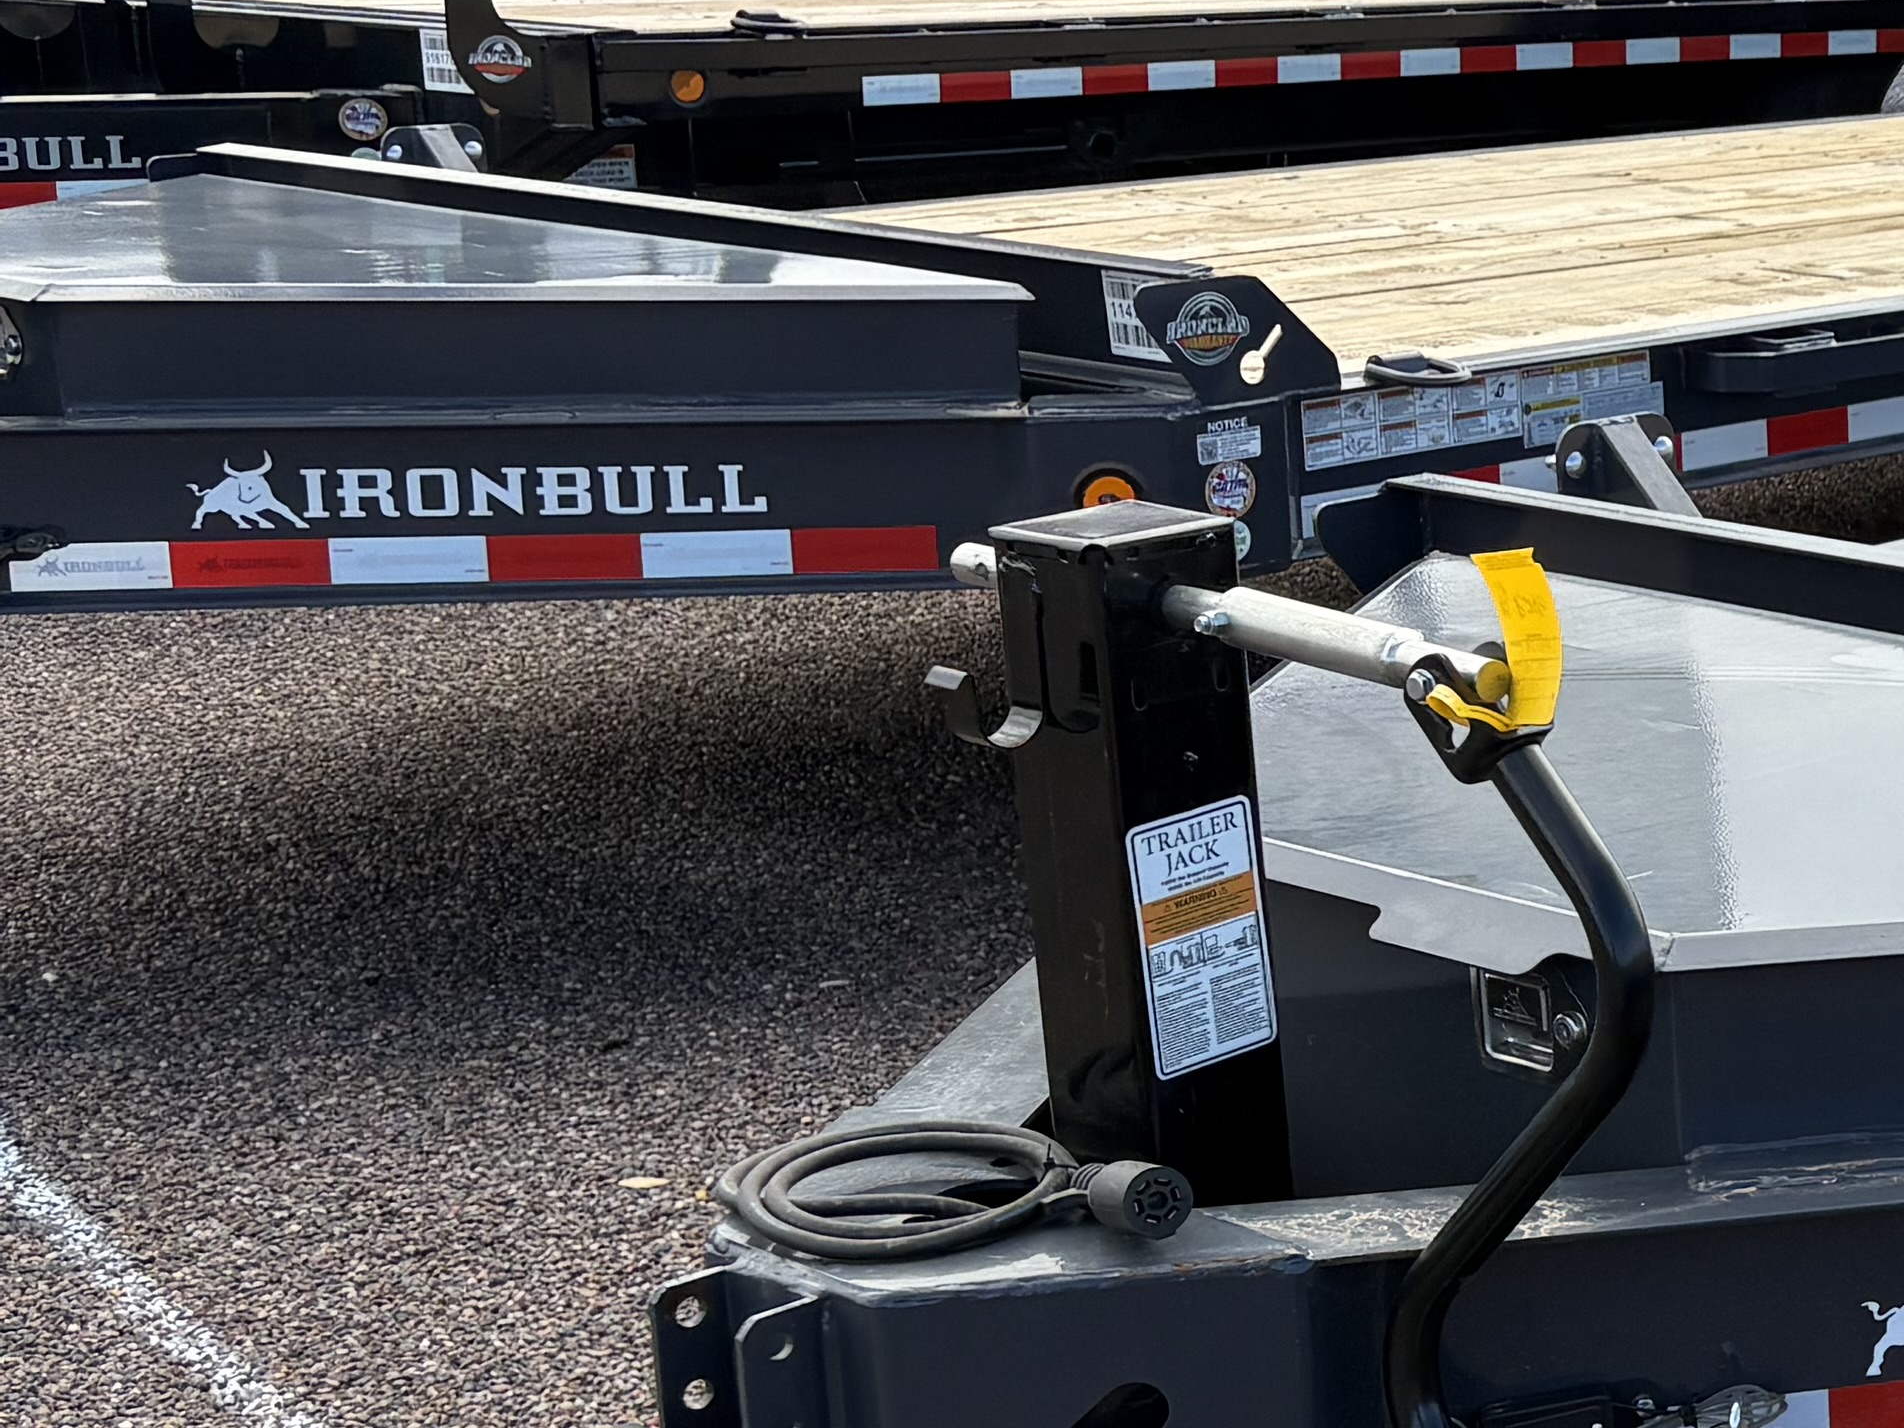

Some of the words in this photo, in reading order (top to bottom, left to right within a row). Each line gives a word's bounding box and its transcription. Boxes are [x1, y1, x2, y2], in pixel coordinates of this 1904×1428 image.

[1207, 416, 1248, 433] NOTICE
[299, 464, 768, 520] IRONBULL
[1141, 811, 1239, 856] TRAILER
[1164, 838, 1221, 877] JACK
